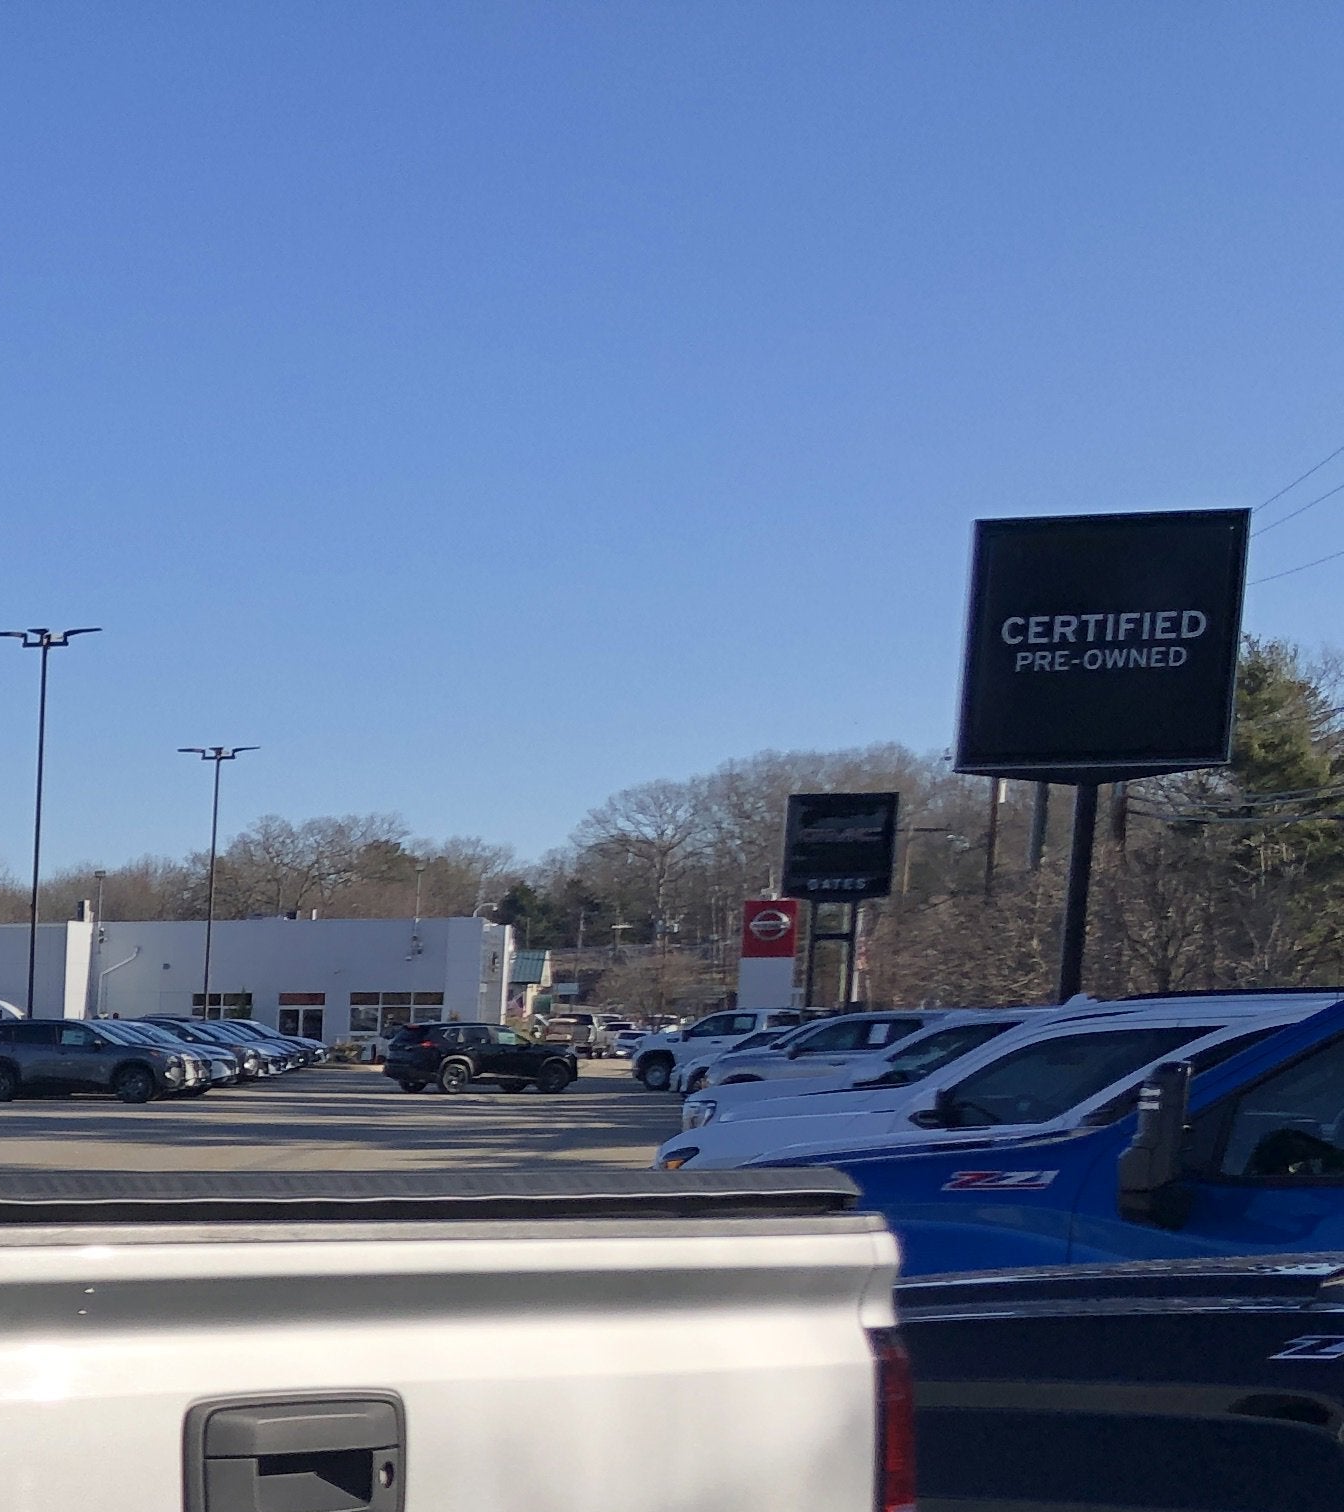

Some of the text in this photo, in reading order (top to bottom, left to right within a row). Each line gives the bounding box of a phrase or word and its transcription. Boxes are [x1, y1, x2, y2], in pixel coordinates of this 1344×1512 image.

[1001, 610, 1207, 645] CERTIFIED
[1015, 647, 1187, 672] PRE-OWNED
[941, 1169, 1060, 1191] Z71
